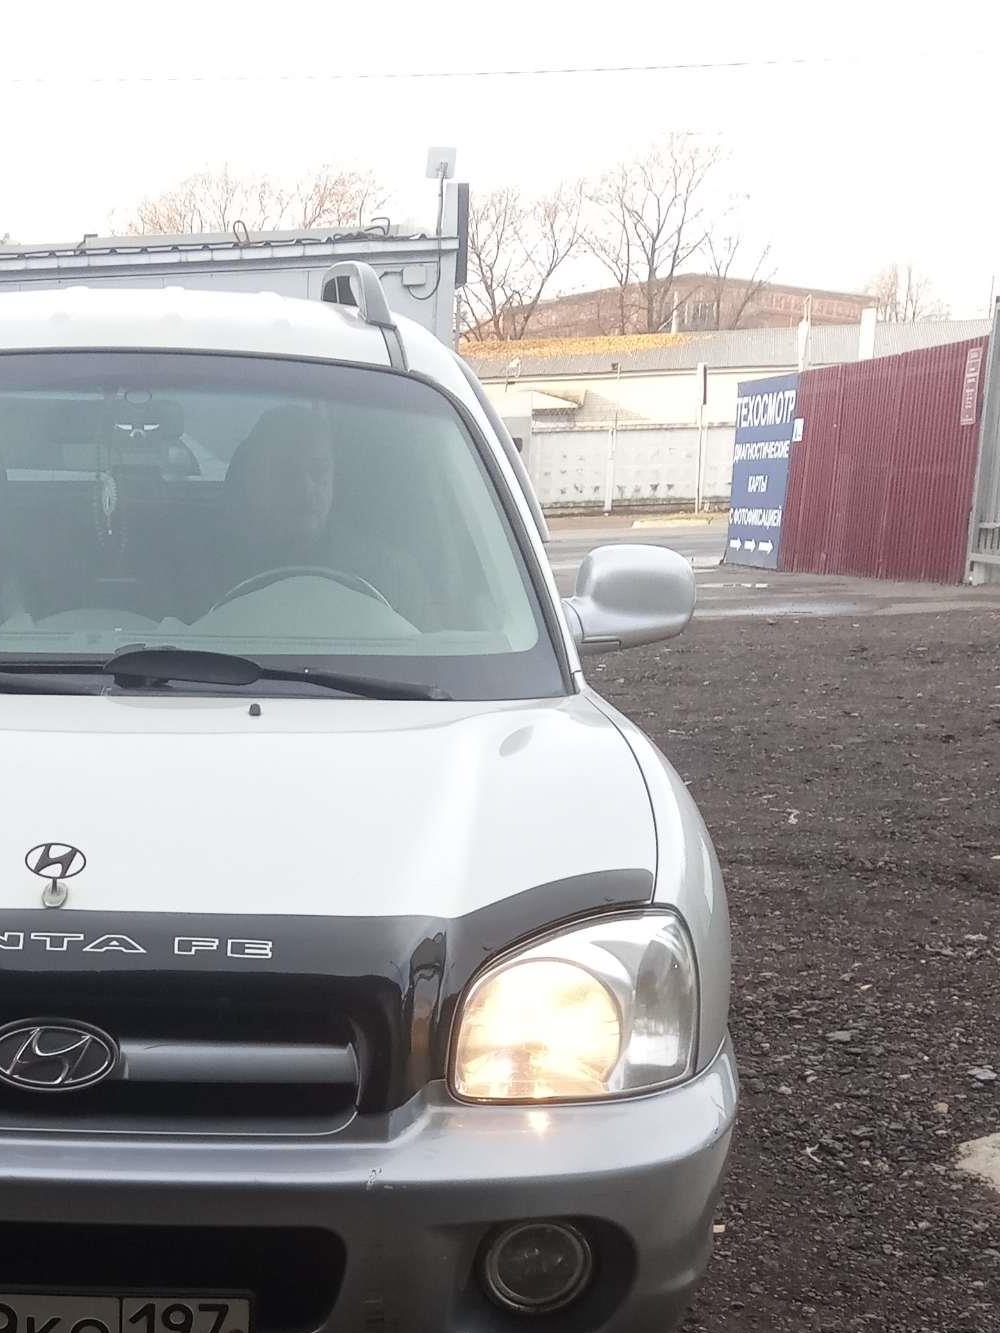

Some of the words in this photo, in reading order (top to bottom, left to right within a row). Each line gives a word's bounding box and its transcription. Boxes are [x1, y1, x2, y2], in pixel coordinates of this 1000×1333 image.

[736, 390, 797, 428] ТЕХОСМОТР
[734, 440, 790, 463] ДИАГНОСТИЧЕСКИЕ
[748, 475, 768, 492] КАРТЫ
[734, 505, 783, 528] ФОТОФИКСАЦИЕЙ
[174, 937, 273, 959] FE
